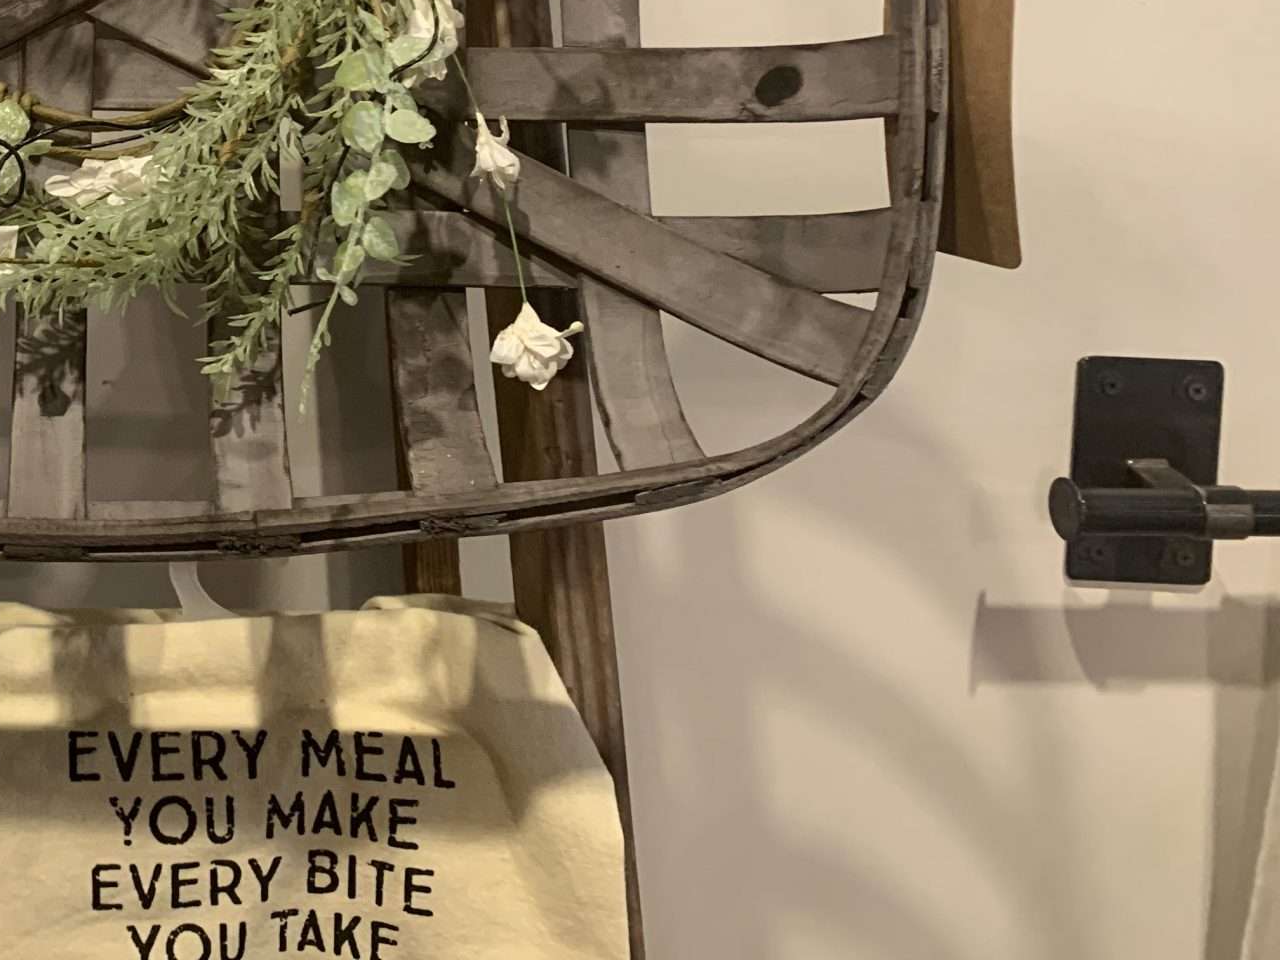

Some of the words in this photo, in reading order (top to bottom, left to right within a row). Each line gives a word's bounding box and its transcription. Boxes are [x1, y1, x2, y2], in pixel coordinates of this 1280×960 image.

[67, 729, 268, 782] EVERY
[301, 729, 456, 789] MEAL
[109, 795, 235, 846] YOU
[265, 790, 419, 850] MAKE
[91, 856, 283, 911] EVERY
[306, 850, 435, 918] BITE
[126, 921, 247, 960] YOU
[270, 908, 399, 960] TAKE
